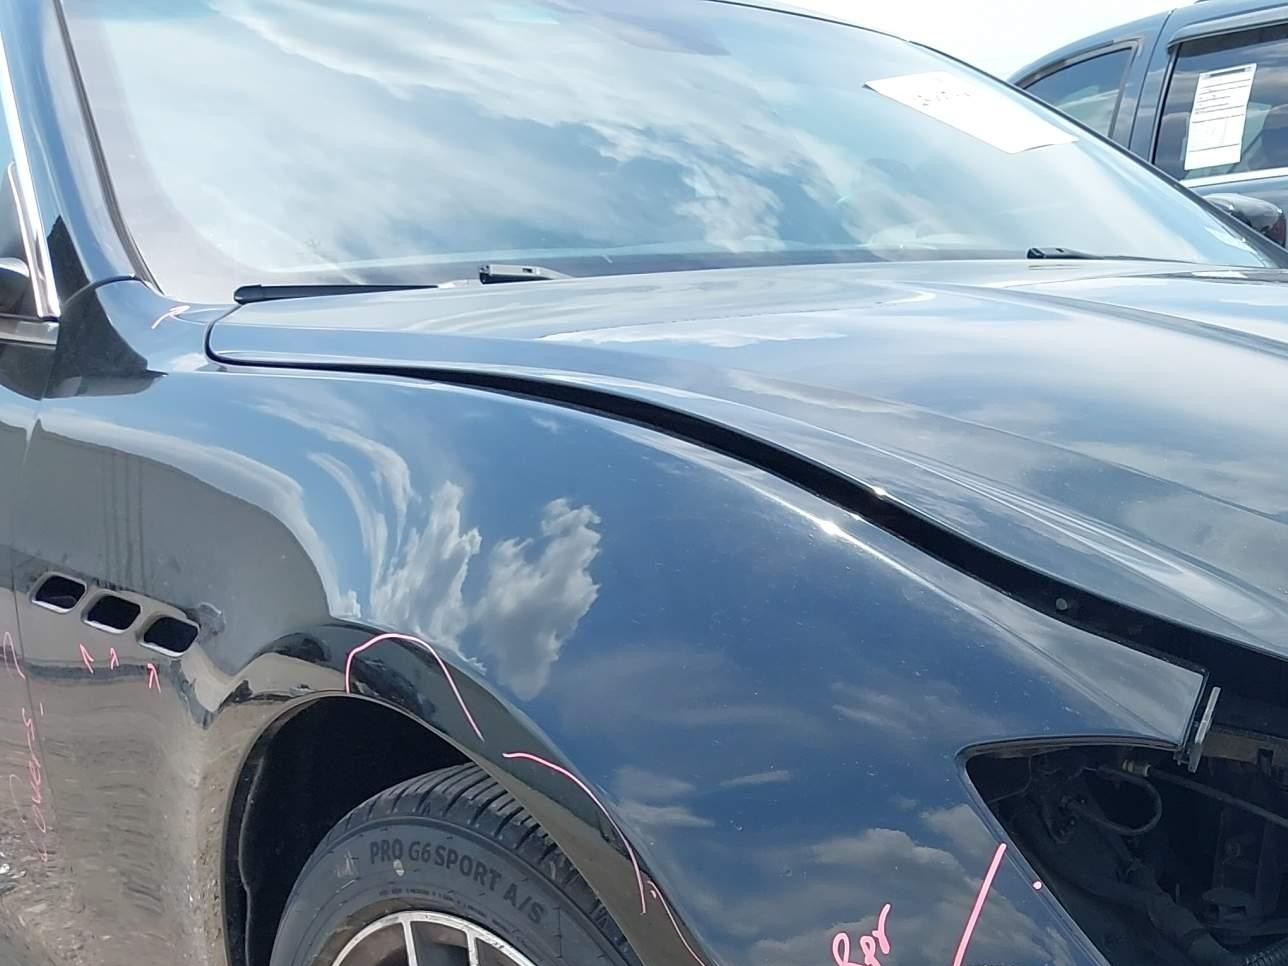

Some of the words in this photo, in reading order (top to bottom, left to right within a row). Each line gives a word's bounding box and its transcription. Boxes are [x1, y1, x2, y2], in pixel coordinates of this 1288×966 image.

[369, 838, 403, 865] PRO
[408, 841, 432, 863] G6
[434, 845, 503, 891] SPORT
[503, 882, 546, 925] A/S
